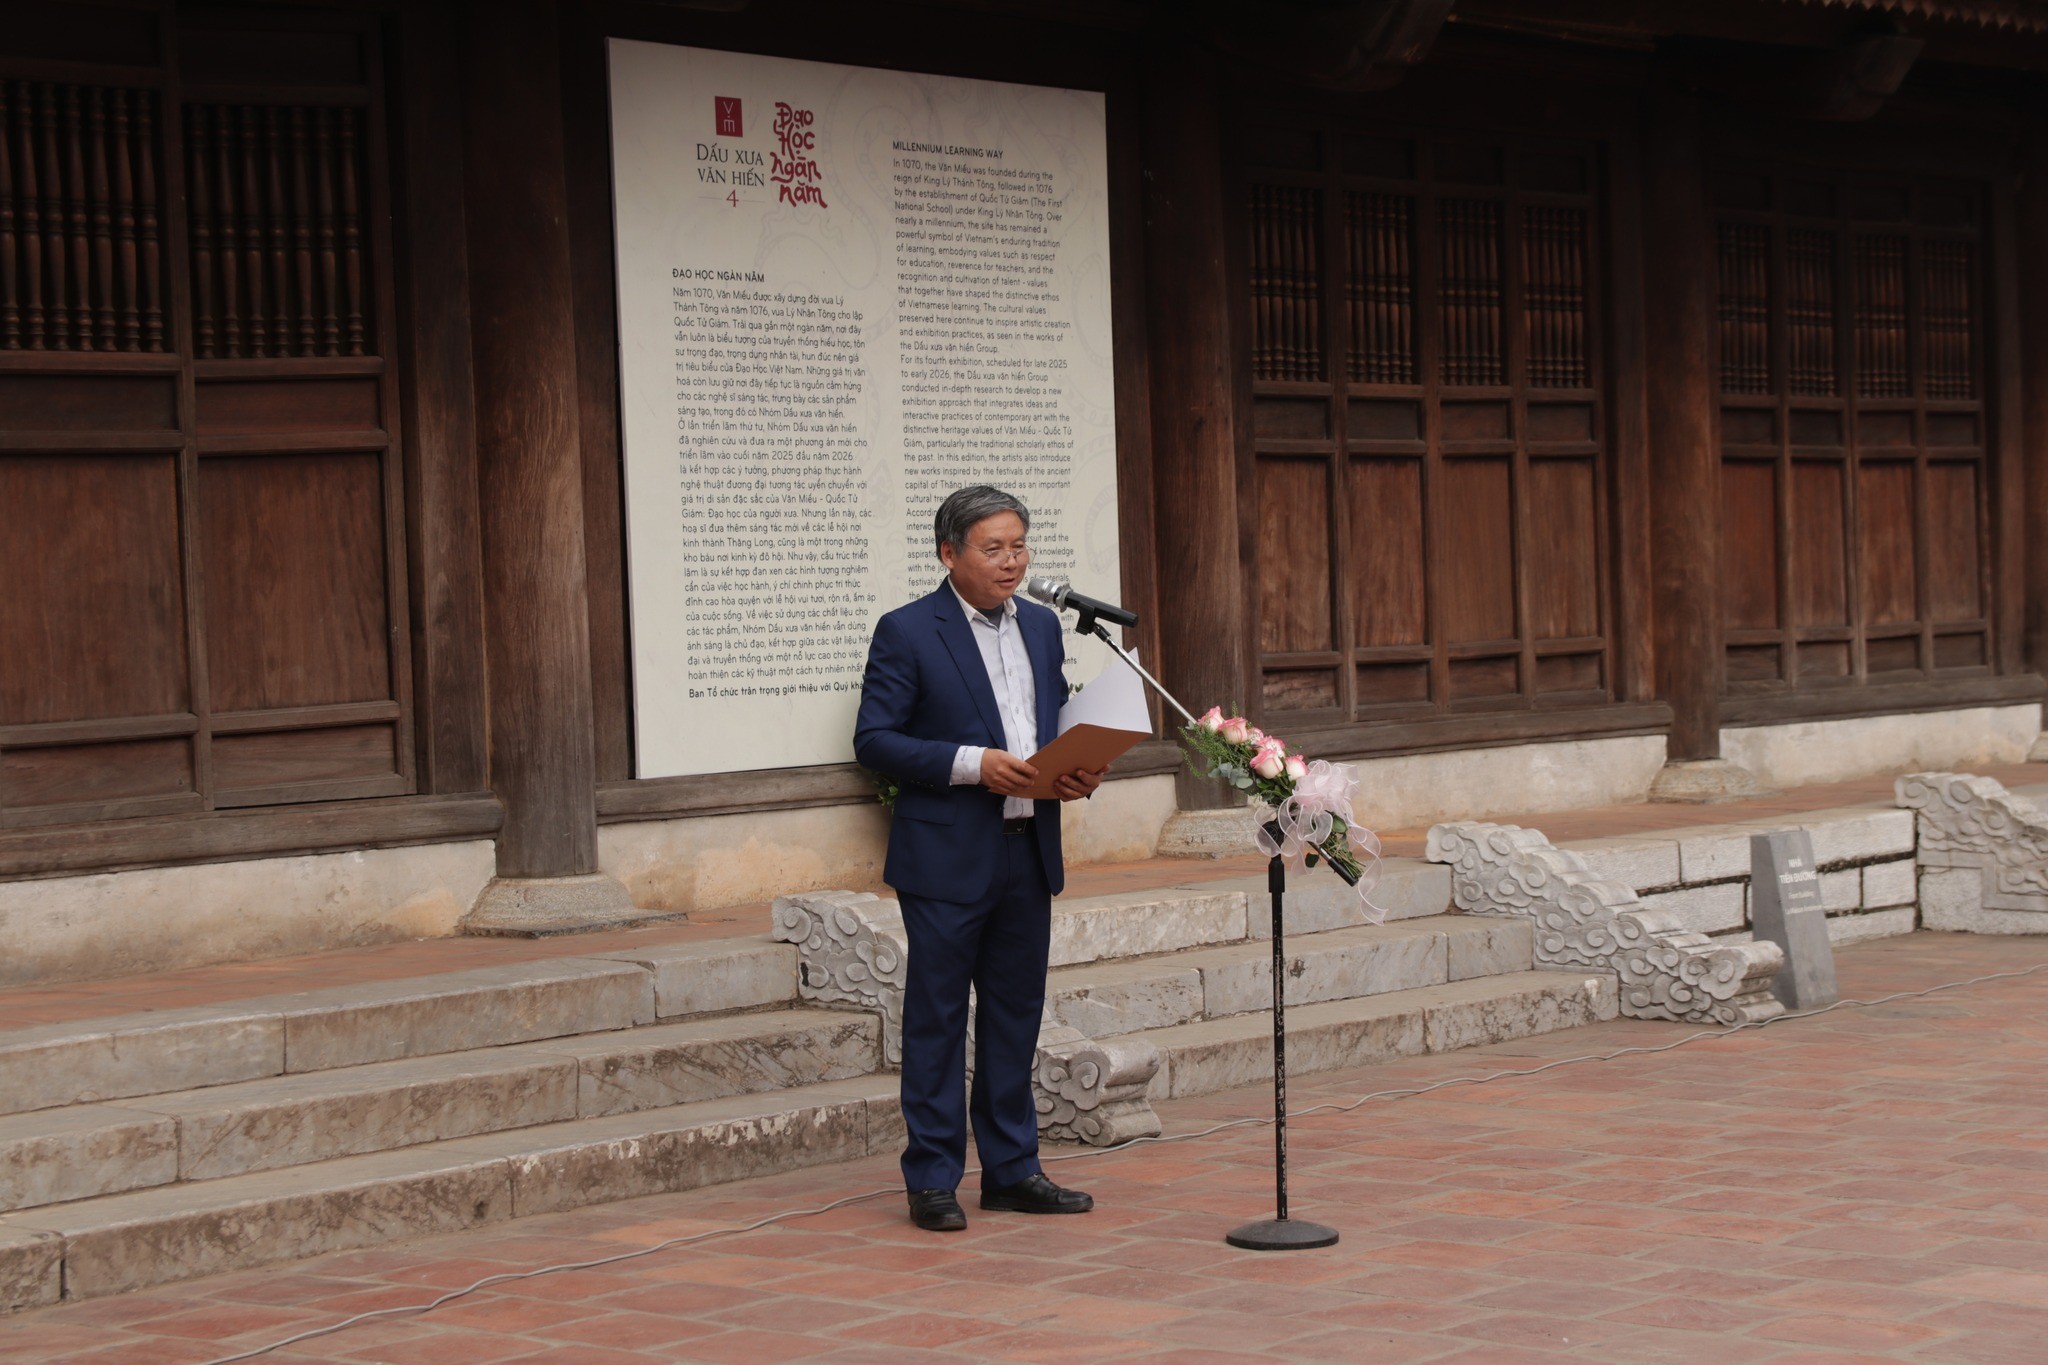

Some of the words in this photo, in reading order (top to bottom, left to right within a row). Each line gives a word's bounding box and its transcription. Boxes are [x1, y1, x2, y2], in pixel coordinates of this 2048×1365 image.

[696, 142, 729, 163] DẤU
[892, 140, 942, 154] MILLENNIUM
[944, 145, 983, 157] LEARNING
[985, 149, 1003, 159] WAY
[893, 157, 900, 167] In
[924, 160, 936, 170] the
[972, 166, 985, 174] was
[987, 166, 1016, 177] founded
[1018, 168, 1040, 182] during
[1041, 170, 1053, 180] the
[697, 167, 726, 184] VĂN
[732, 167, 765, 187] HIẾN
[725, 189, 739, 208] 4
[897, 284, 912, 294] that
[914, 285, 944, 298] together
[946, 287, 962, 296] have
[965, 288, 990, 300] shaped
[992, 289, 1003, 299] the
[1005, 290, 1039, 300] distinctive
[1040, 292, 1059, 301] ethos
[821, 296, 834, 304] vua
[900, 354, 912, 363] For
[914, 354, 923, 364] its
[925, 355, 946, 364] fourth
[986, 357, 1021, 367] scheduled
[1022, 358, 1032, 367] for
[1034, 359, 1046, 368] late
[1048, 359, 1067, 369] 2025
[901, 382, 939, 392] conducted
[941, 383, 971, 395] in-depth
[973, 384, 1003, 394] research
[1005, 385, 1012, 394] to
[1014, 385, 1040, 397] develop
[901, 396, 936, 406] exhibition
[938, 397, 971, 409] approach
[973, 398, 987, 407] that
[989, 398, 1023, 410] integrates
[1025, 399, 1043, 408] ideas
[1045, 399, 1057, 408] and
[902, 410, 939, 419] interactive
[941, 410, 973, 423] practices
[974, 411, 982, 420] of
[984, 411, 1031, 424] contemporary
[1033, 413, 1042, 421] art
[1043, 413, 1057, 422] with
[1059, 413, 1069, 422] the
[926, 438, 964, 450] particularly
[966, 438, 978, 447] the
[980, 439, 1014, 448] traditional
[1016, 439, 1045, 451] scholarly
[1046, 440, 1065, 448] ethos
[1066, 440, 1074, 449] of
[771, 451, 793, 460] 2025
[832, 451, 853, 461] 2026
[904, 451, 915, 460] the
[937, 452, 944, 461] In
[946, 452, 959, 461] this
[988, 452, 999, 461] the
[1001, 452, 1022, 461] artists
[1024, 453, 1037, 462] also
[1039, 453, 1070, 462] introduce
[920, 465, 940, 474] works
[942, 466, 970, 477] inspired
[972, 466, 980, 477] by
[983, 466, 994, 475] the
[996, 466, 1023, 475] festivals
[1025, 466, 1032, 475] of
[1033, 466, 1044, 475] the
[1047, 466, 1070, 475] ancient
[682, 538, 699, 548] kinh
[823, 536, 843, 548] trong
[1039, 546, 1073, 558] knowledge
[688, 688, 704, 698] Ban
